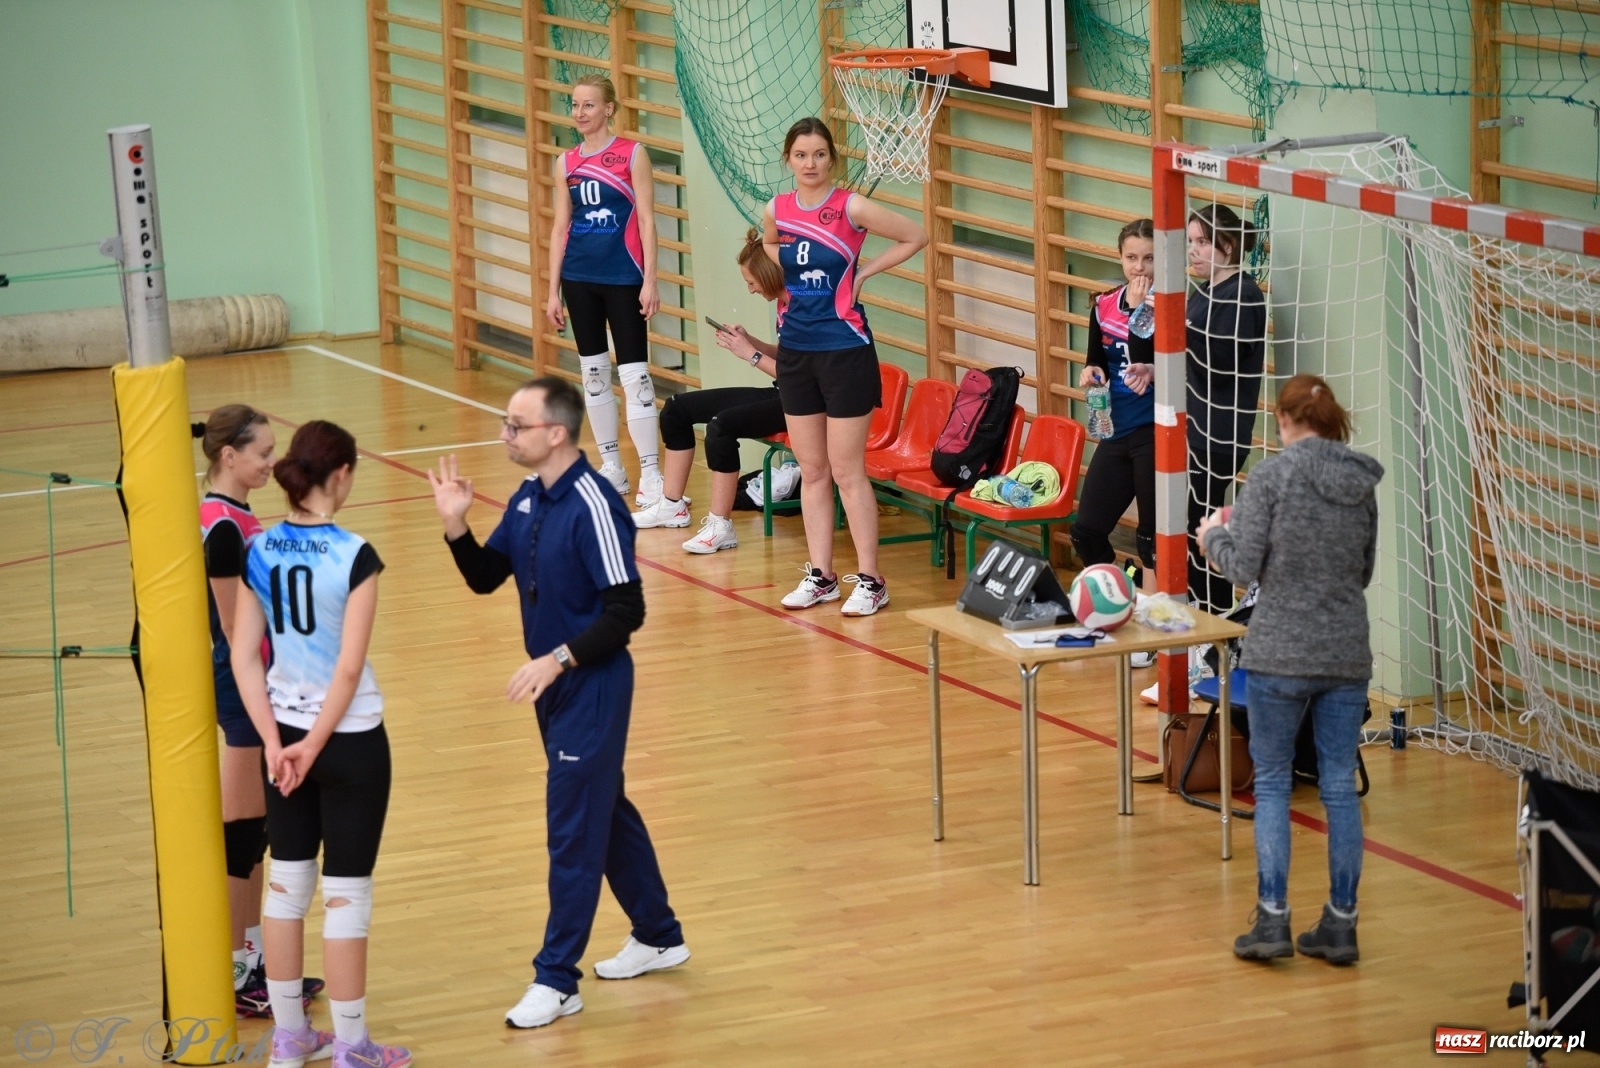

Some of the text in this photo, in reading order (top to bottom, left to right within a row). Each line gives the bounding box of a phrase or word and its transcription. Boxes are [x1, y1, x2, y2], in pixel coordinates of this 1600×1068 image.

[1198, 160, 1218, 173] sport
[580, 180, 601, 205] 10
[140, 218, 153, 288] sport
[796, 241, 811, 266] 8
[264, 537, 330, 554] EMERLING
[270, 564, 317, 636] 10
